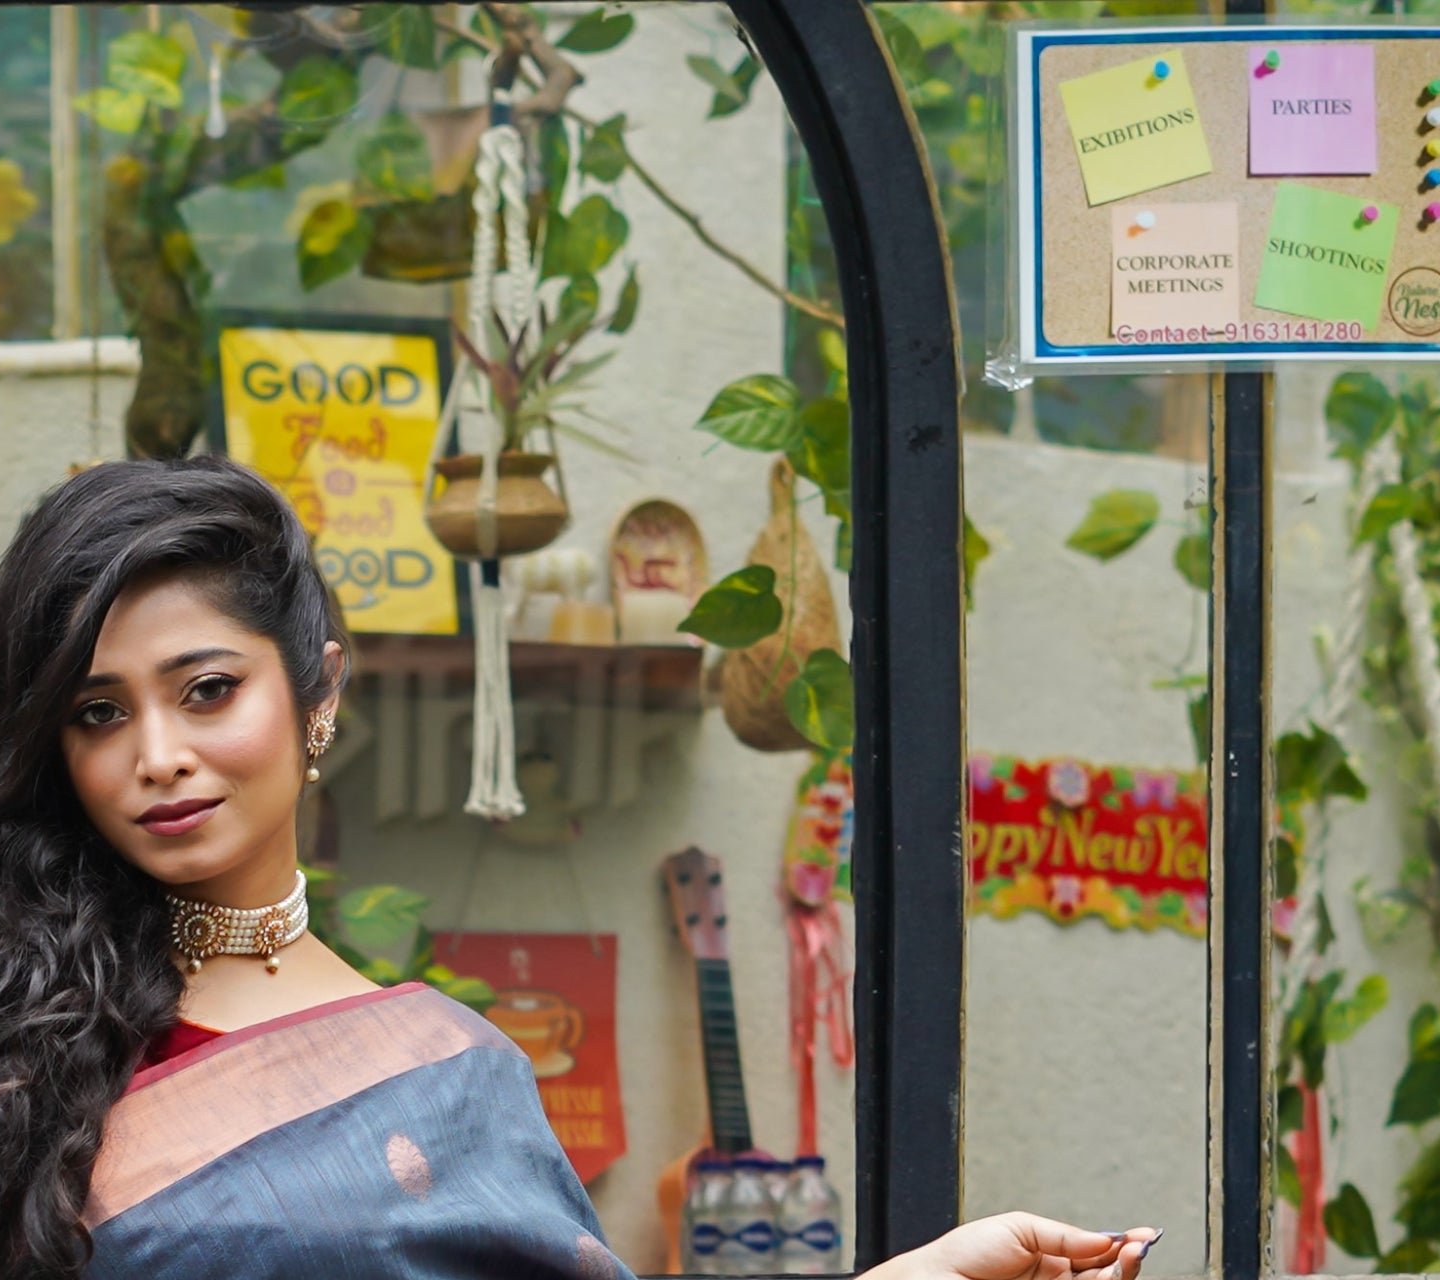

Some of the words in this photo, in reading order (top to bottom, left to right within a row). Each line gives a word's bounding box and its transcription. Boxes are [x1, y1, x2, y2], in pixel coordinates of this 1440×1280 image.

[1271, 99, 1353, 116] PARTIES
[1078, 108, 1195, 154] EXIBITIONS
[1116, 253, 1234, 272] CORPORATE
[1268, 238, 1386, 275] SHOOTINGS
[1127, 277, 1225, 295] MEETINGS
[1225, 322, 1362, 342] 9163141280
[241, 360, 421, 407] GOOD
[282, 412, 387, 464] Food
[317, 546, 435, 589] OOD
[1039, 806, 1153, 873] New
